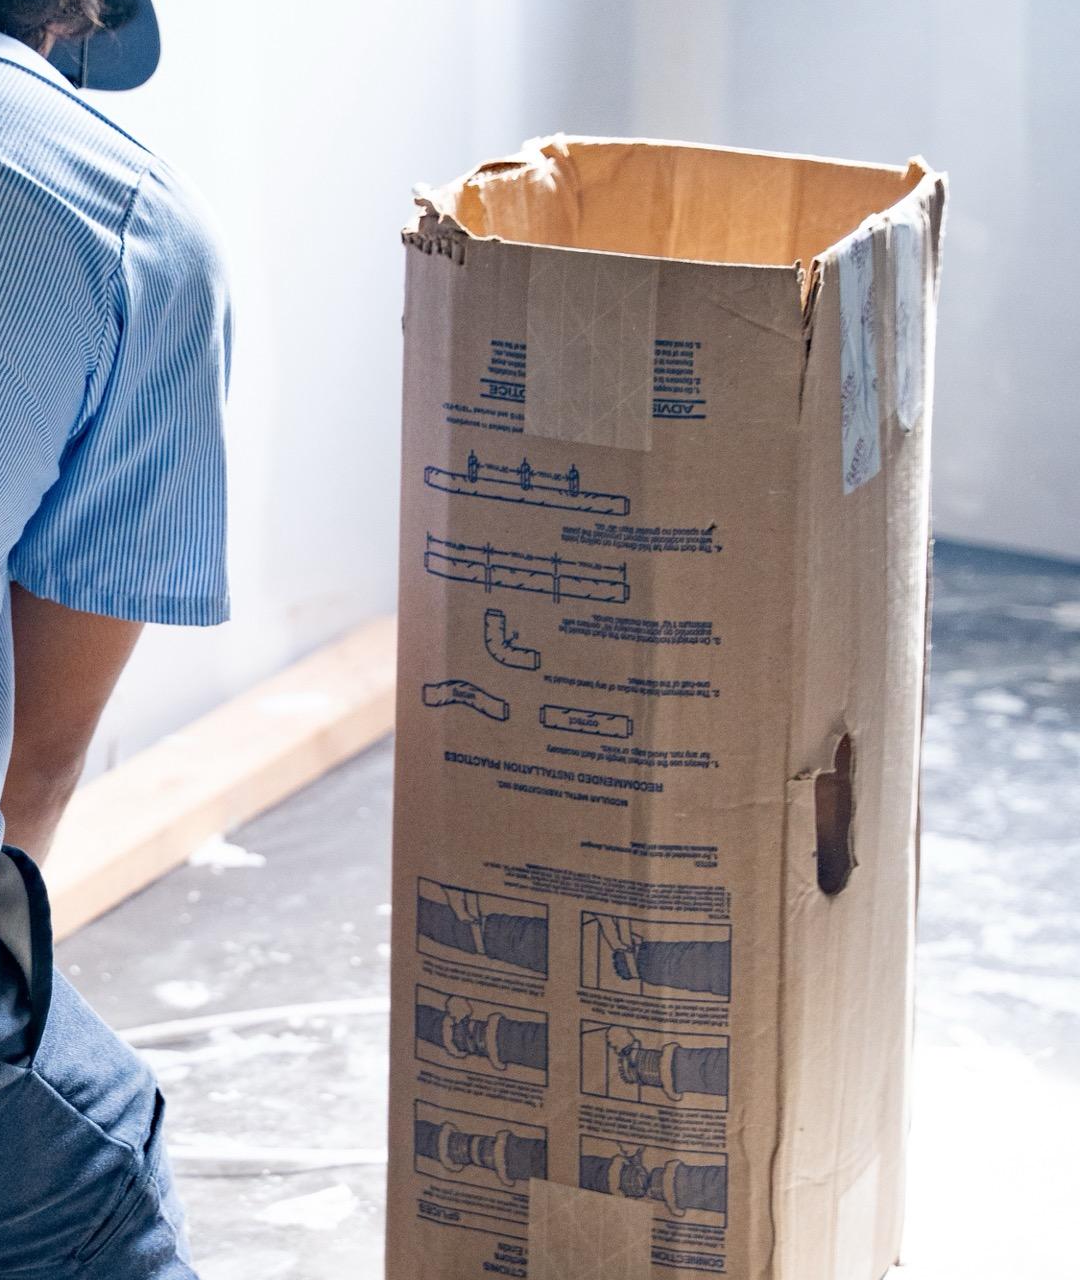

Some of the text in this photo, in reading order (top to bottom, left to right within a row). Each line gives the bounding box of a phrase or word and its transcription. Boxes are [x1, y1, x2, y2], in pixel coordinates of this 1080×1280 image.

[567, 717, 600, 728] correct
[444, 751, 663, 793] RECOMMENDED INSTALLATION PRACTICES
[564, 791, 588, 801] METAL
[590, 794, 628, 807] MODULAR
